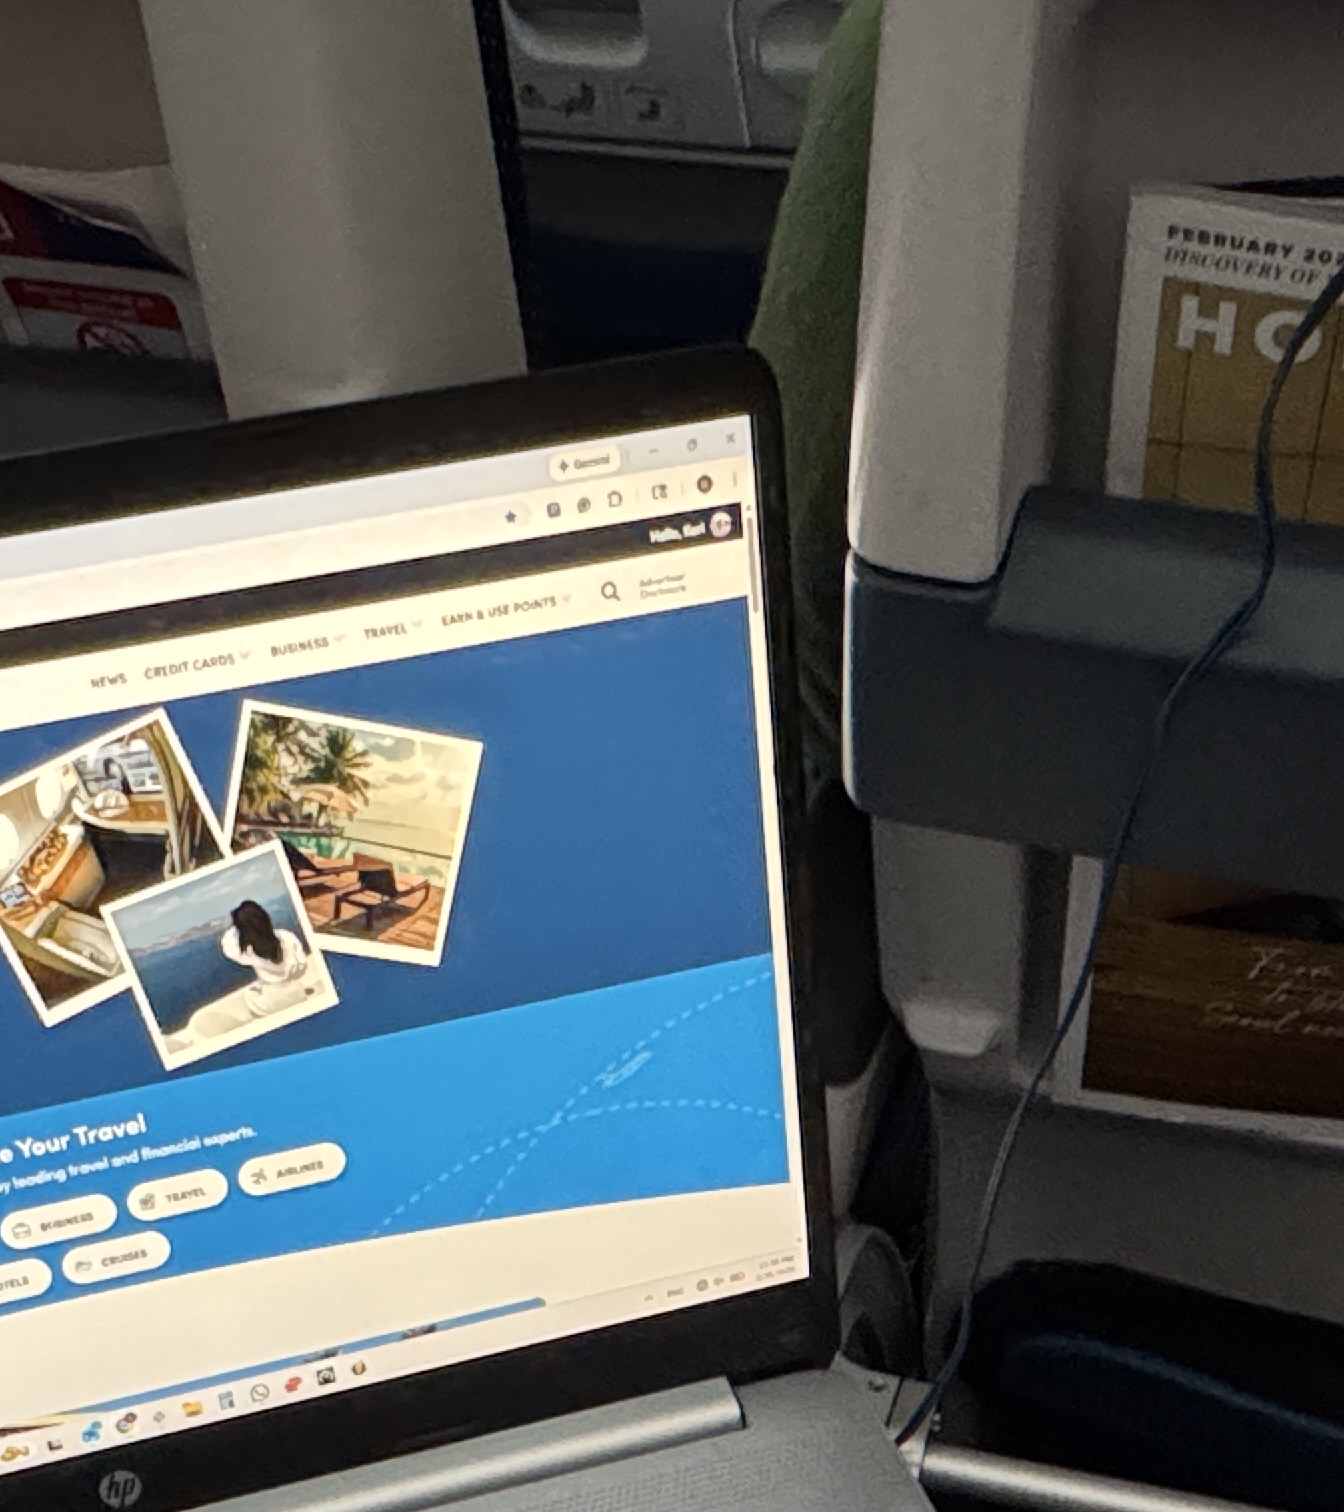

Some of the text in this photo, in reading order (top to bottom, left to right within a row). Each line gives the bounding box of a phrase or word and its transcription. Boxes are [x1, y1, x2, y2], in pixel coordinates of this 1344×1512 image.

[1167, 224, 1295, 259] FEBRUARY
[1164, 246, 1288, 281] DISCOVERY
[1289, 267, 1322, 285] OF
[441, 611, 474, 626] EARN
[488, 604, 510, 618] USE
[513, 595, 557, 613] POINTS
[363, 622, 408, 641] TRAVEL
[270, 636, 329, 657] BUSINESS
[143, 653, 236, 681] CREDIT CARDS
[90, 672, 128, 690] NEWS
[15, 1132, 71, 1159] Your
[73, 1112, 147, 1147] Travel
[12, 1165, 67, 1192] leading
[68, 1156, 110, 1178] travel
[111, 1149, 140, 1167] and
[141, 1135, 202, 1161] financial
[202, 1126, 258, 1149] experts.
[275, 1159, 325, 1180] AIRLINES
[164, 1186, 208, 1204] TRAVEL
[39, 1211, 94, 1233] BUSINESS
[100, 1248, 149, 1269] CRUISES
